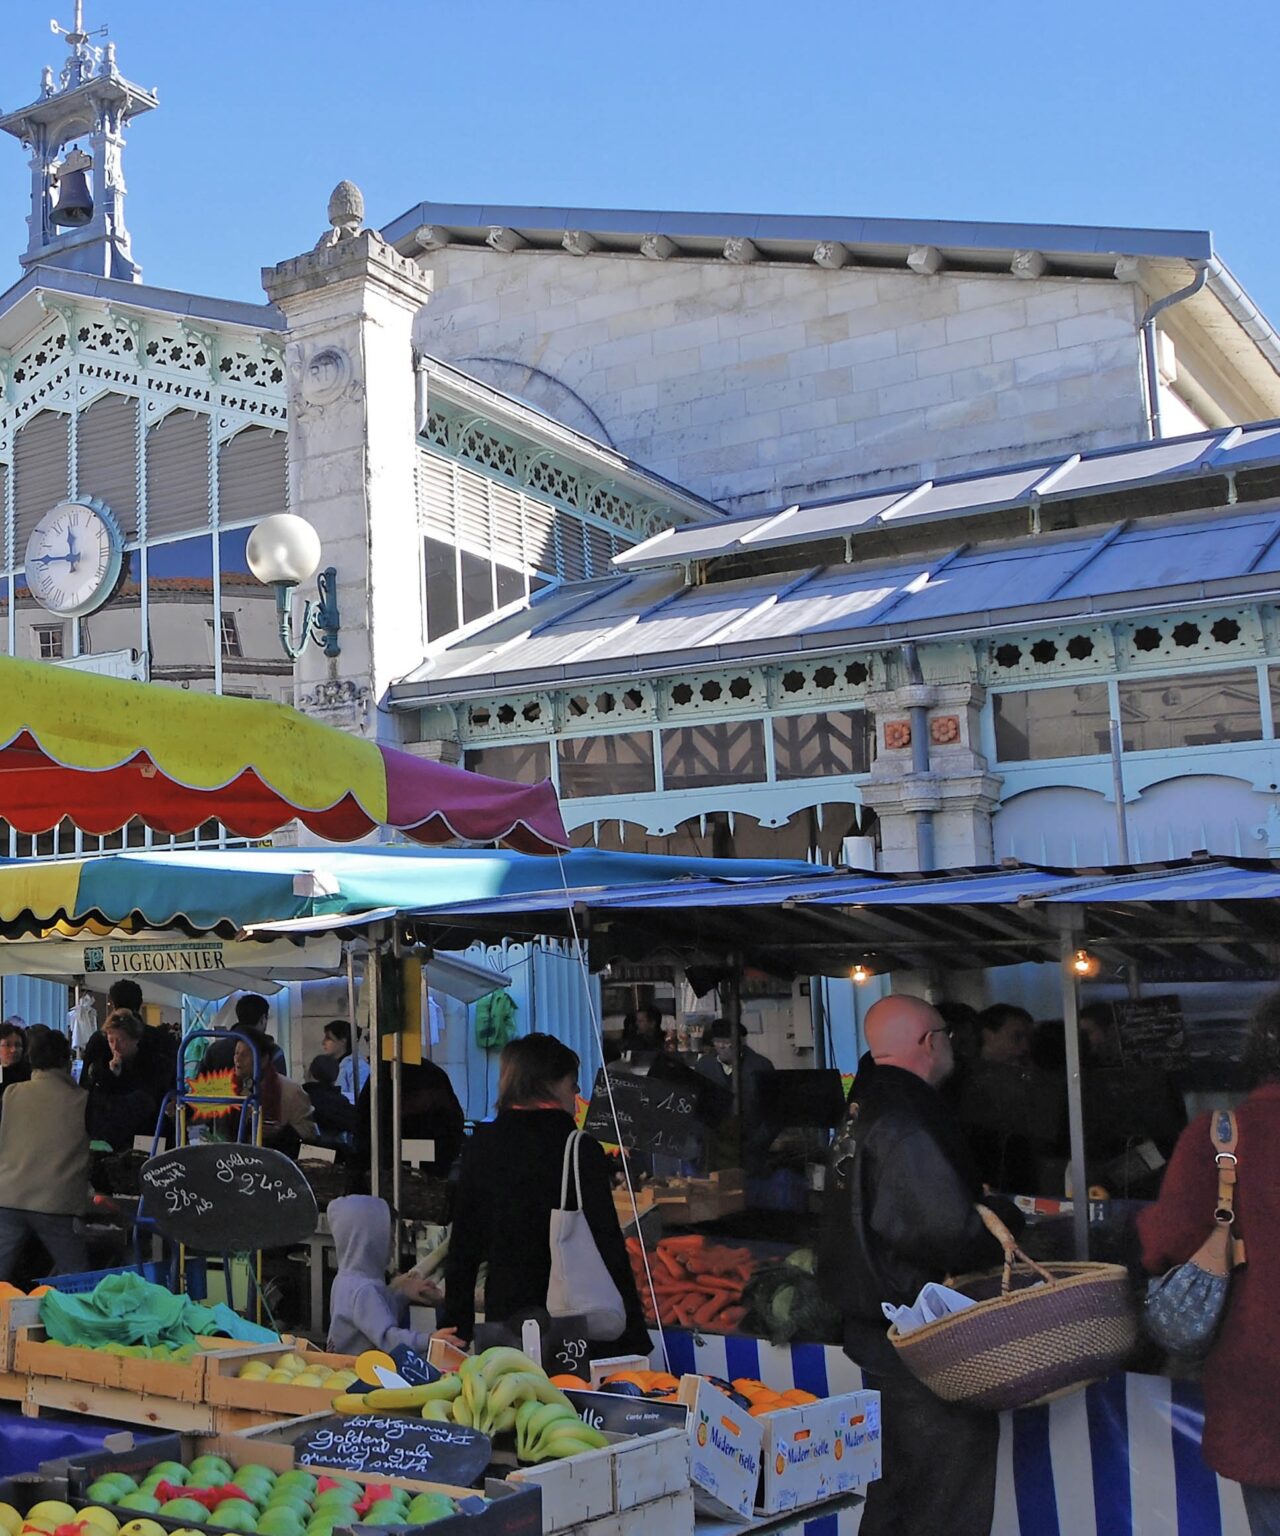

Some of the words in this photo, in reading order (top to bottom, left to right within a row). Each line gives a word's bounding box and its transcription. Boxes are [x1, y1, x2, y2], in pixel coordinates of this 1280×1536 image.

[111, 951, 225, 972] PIGEONNIER
[308, 1430, 386, 1450] Golden
[337, 1443, 390, 1462] Royal
[388, 1444, 433, 1462] gala
